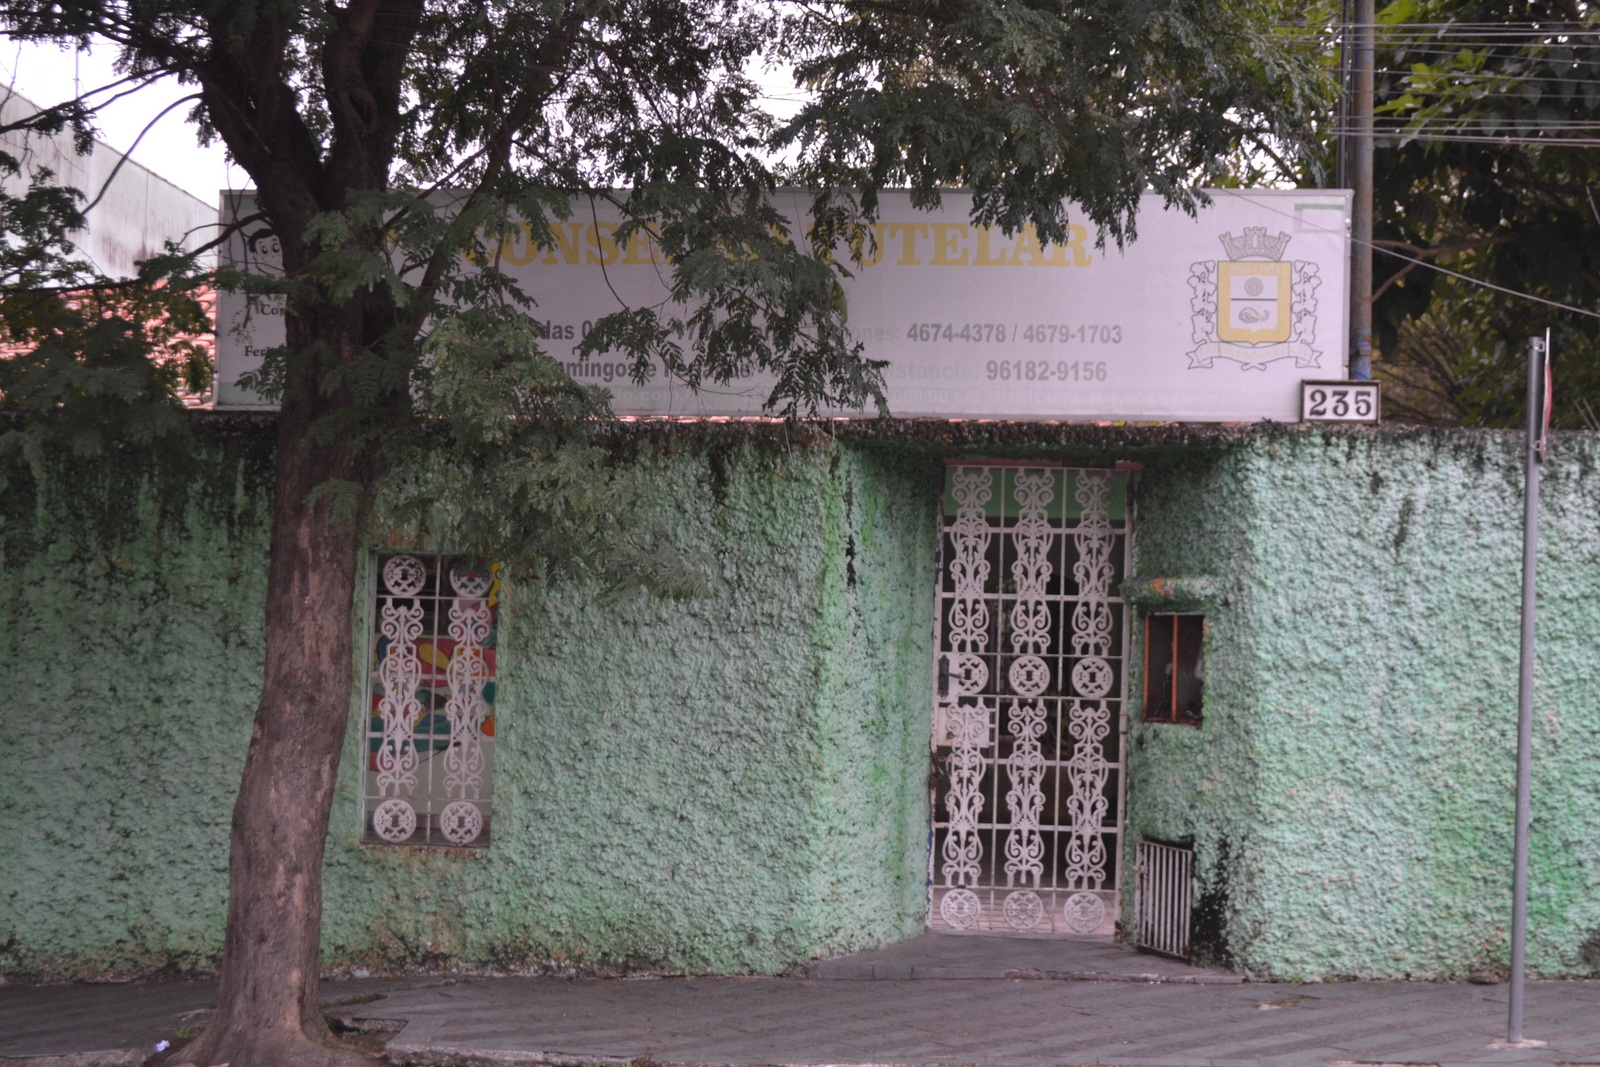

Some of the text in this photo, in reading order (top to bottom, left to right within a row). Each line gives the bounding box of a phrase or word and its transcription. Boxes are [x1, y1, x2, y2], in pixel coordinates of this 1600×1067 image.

[907, 323, 1007, 343] 4674-4378
[1023, 324, 1123, 344] 4679-1703
[986, 360, 1108, 381] 96182-9156
[1310, 390, 1372, 417] 235
